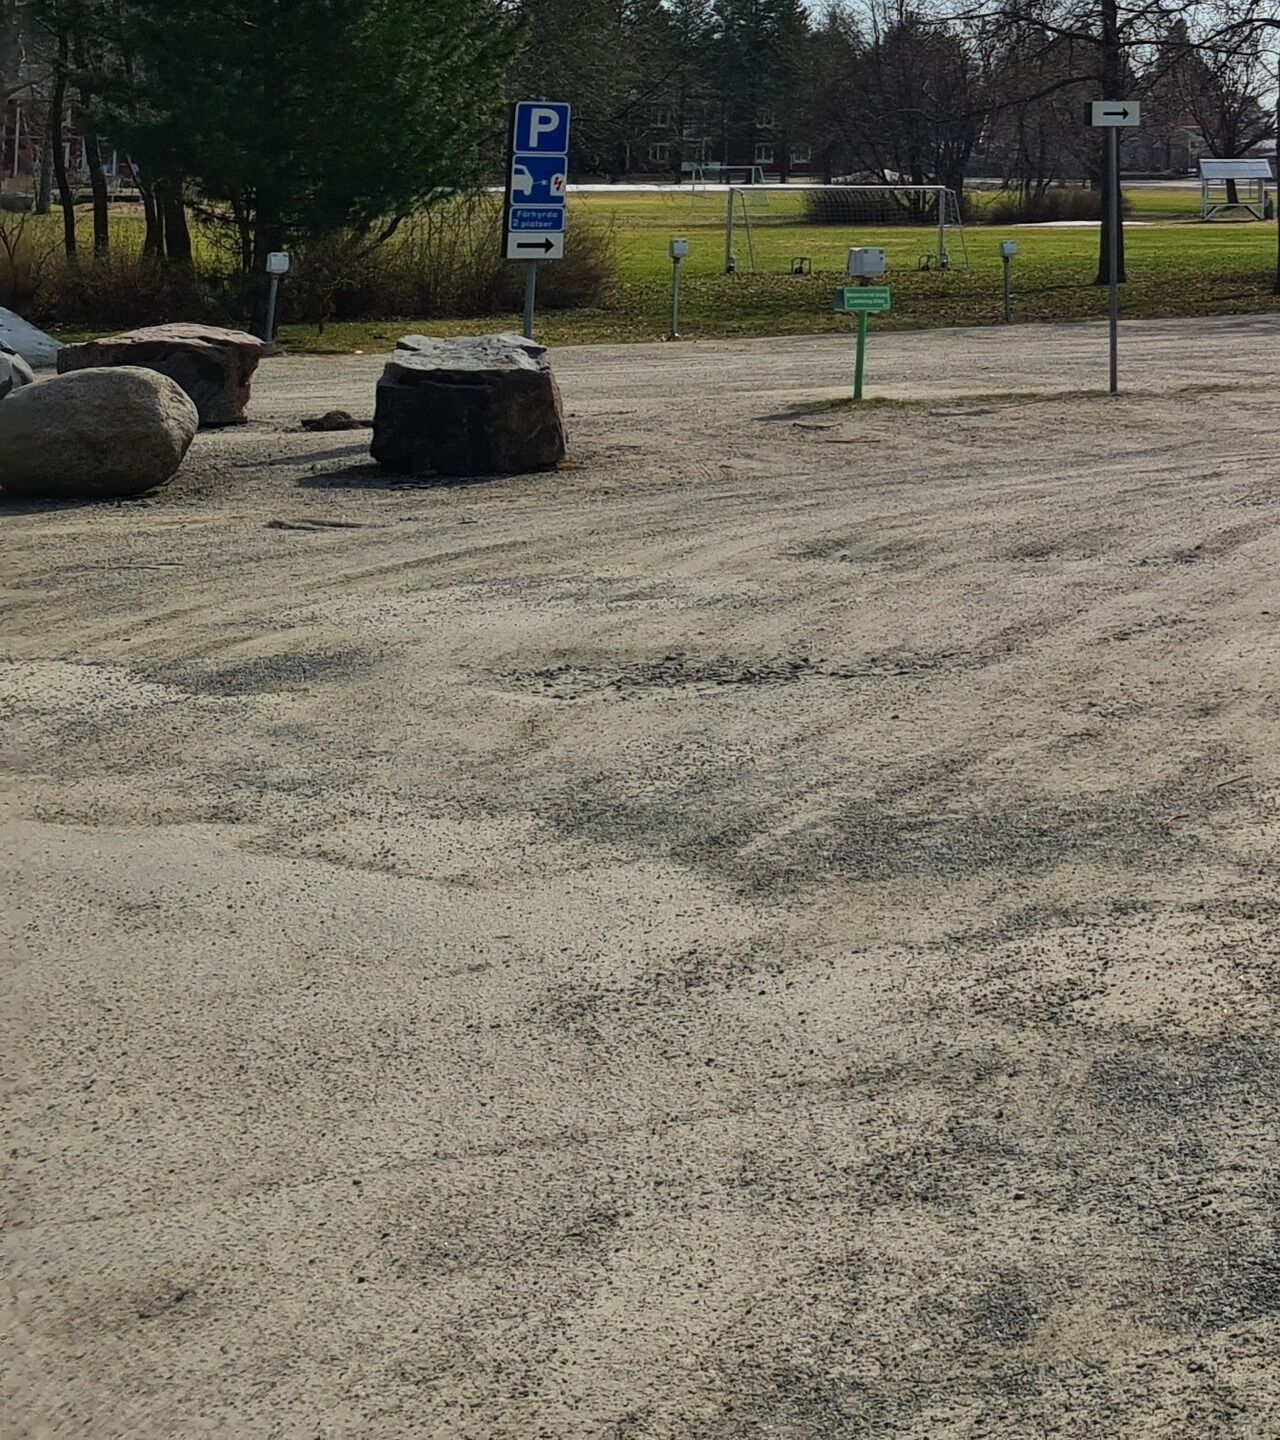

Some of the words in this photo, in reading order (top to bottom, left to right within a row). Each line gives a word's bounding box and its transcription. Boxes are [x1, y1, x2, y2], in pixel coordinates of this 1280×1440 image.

[529, 108, 560, 148] P
[512, 218, 520, 227] 2
[521, 220, 553, 229] platser
